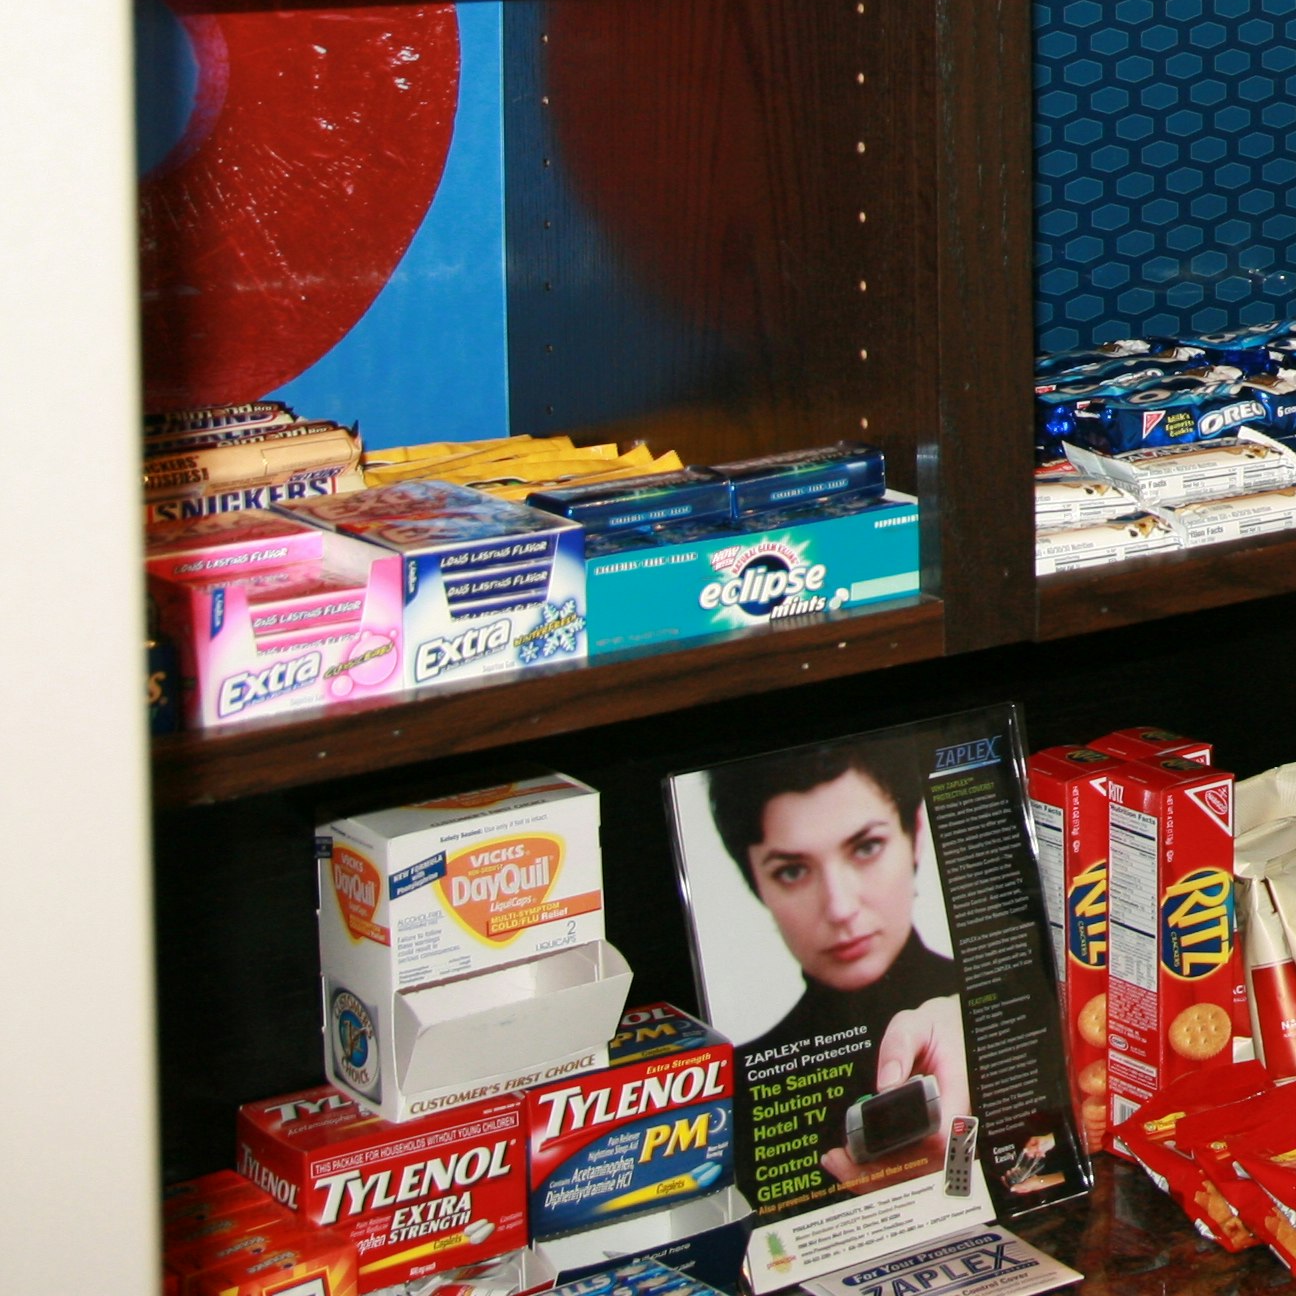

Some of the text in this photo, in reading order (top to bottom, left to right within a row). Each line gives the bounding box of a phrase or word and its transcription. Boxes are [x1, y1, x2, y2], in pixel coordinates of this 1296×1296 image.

[1200, 401, 1267, 436] OREO
[1277, 406, 1284, 417] 6
[154, 476, 331, 523] SNICKERS
[206, 547, 288, 569] LASTING FLAVOR
[440, 541, 548, 568] LONG LASTING FLAVOR
[472, 571, 548, 593] LASTING FLAVOR
[699, 563, 827, 611] eclipse
[280, 600, 362, 623] LASTING FLAVOR
[769, 592, 827, 621] mints
[415, 618, 512, 683] Extra
[219, 651, 323, 719] Extra
[936, 736, 1002, 769] ZAPLEX
[1109, 780, 1124, 804] RITZ
[1044, 805, 1063, 818] Facts
[1109, 803, 1157, 826] Nutrition Facts
[340, 851, 364, 873] VICKS
[392, 854, 444, 883] NEW FORMULA
[470, 843, 526, 868] VICKS
[334, 865, 377, 908] DayQuil
[452, 855, 550, 908] DayQuil
[490, 902, 560, 924] MULTI-SYMPTOM
[541, 907, 569, 921] Relief
[566, 920, 577, 936] 2
[1166, 872, 1229, 976] RITZ
[611, 1022, 678, 1049] PM
[814, 1024, 868, 1048] Remote
[646, 1053, 712, 1075] Extra Strength
[747, 1039, 872, 1082] Control Protectors
[409, 1054, 596, 1116] CUSTOMER'S FIRST CHOICE
[749, 1062, 854, 1102] The Sanitary
[538, 1060, 725, 1140] TYLENOL
[752, 1085, 845, 1122] Solution to
[637, 1112, 711, 1164] PM
[753, 1107, 828, 1143] Hotel TV
[315, 1116, 516, 1175] THIS PACKAGE FOR HOUSEHOLDS WITHOUT YOUNG CHILDREN
[754, 1133, 819, 1162] Remote
[240, 1142, 298, 1210] TYLENOL
[313, 1139, 512, 1226] TYLENOL
[755, 1151, 819, 1182] Control
[656, 1179, 685, 1196] Caplets
[756, 1170, 823, 1203] GERMS
[759, 1156, 930, 1216] Also prevents loss of and their covers
[387, 1210, 473, 1245] STRENGTH
[391, 1191, 473, 1231] EXTRA
[853, 1234, 993, 1285] For Your Protection
[860, 1241, 1030, 1296] ZAPLEX
[999, 1271, 1029, 1284] Cover
